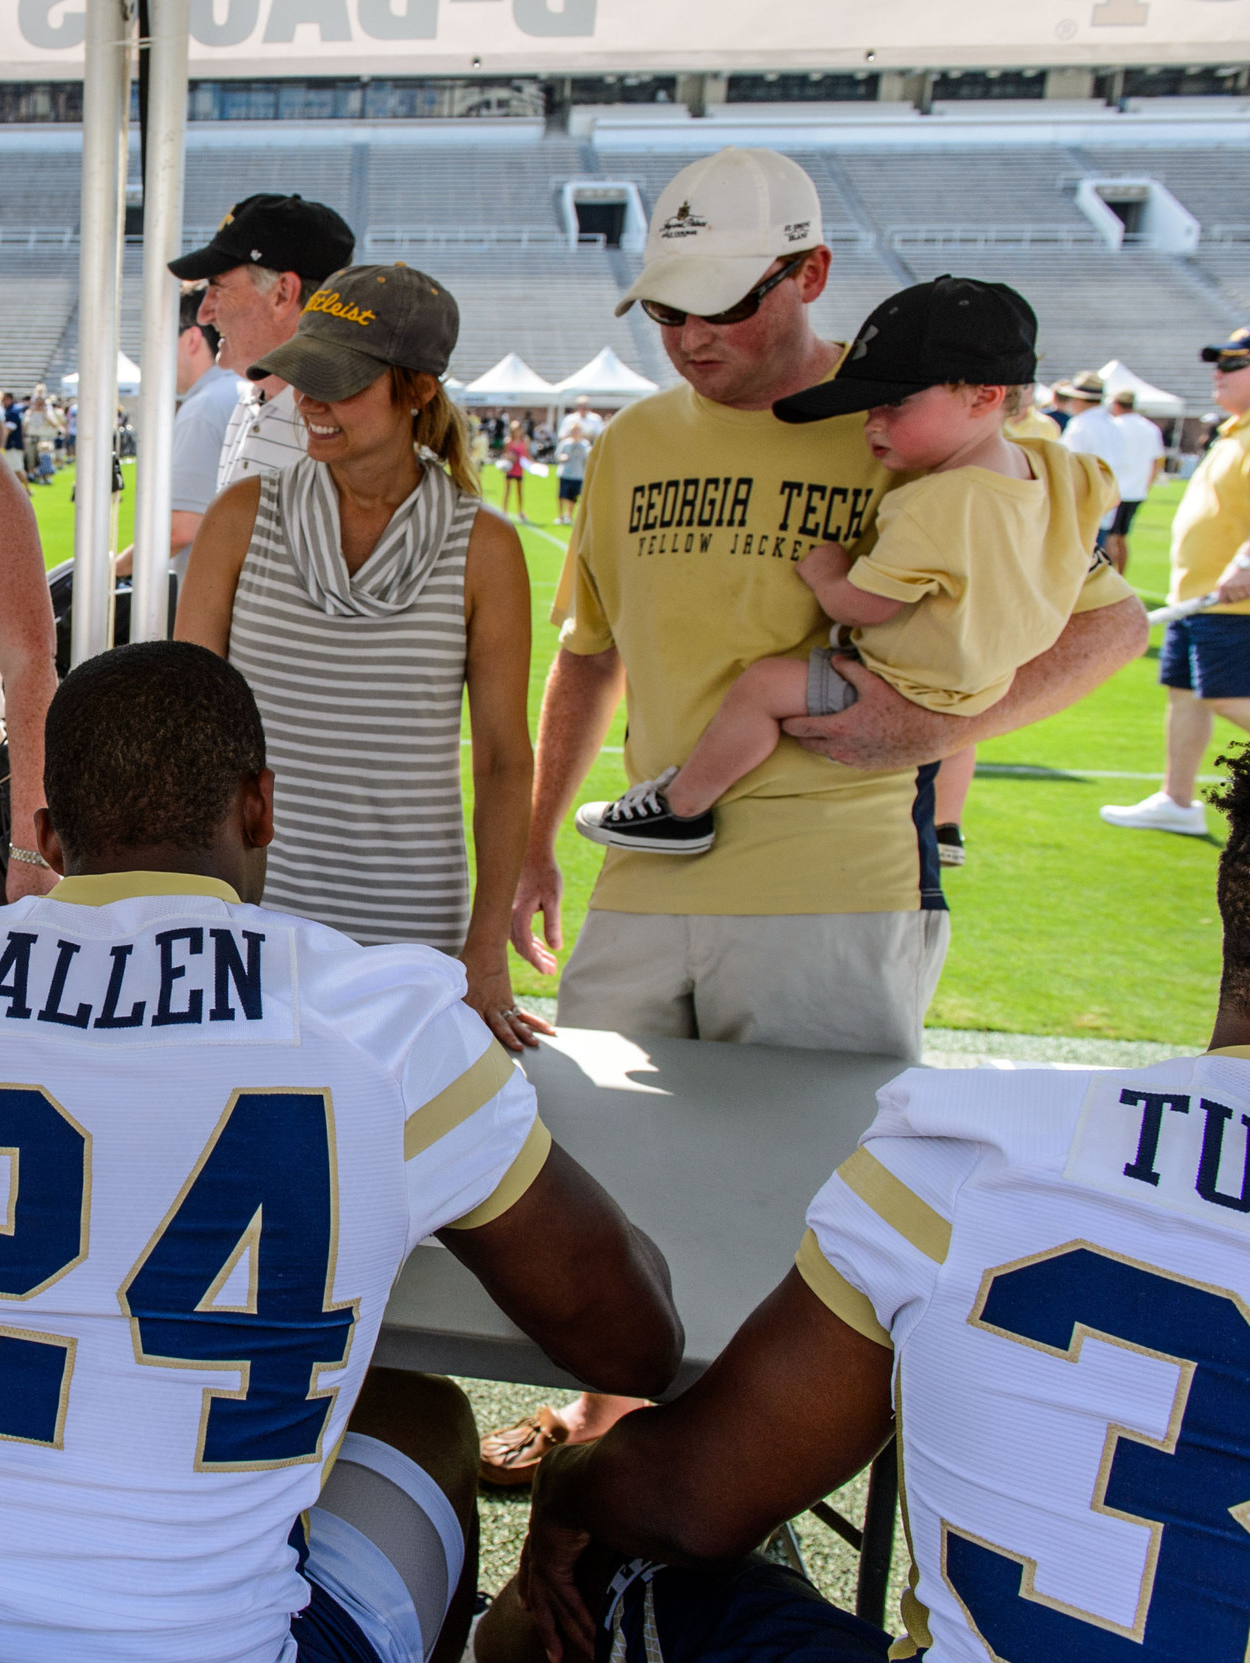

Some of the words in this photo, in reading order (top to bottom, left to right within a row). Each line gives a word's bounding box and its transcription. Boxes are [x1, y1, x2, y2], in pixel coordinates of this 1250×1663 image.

[628, 477, 754, 534] GEORGIA
[778, 480, 874, 542] TECH
[637, 533, 713, 556] YELLOW
[730, 534, 817, 562] JACKE
